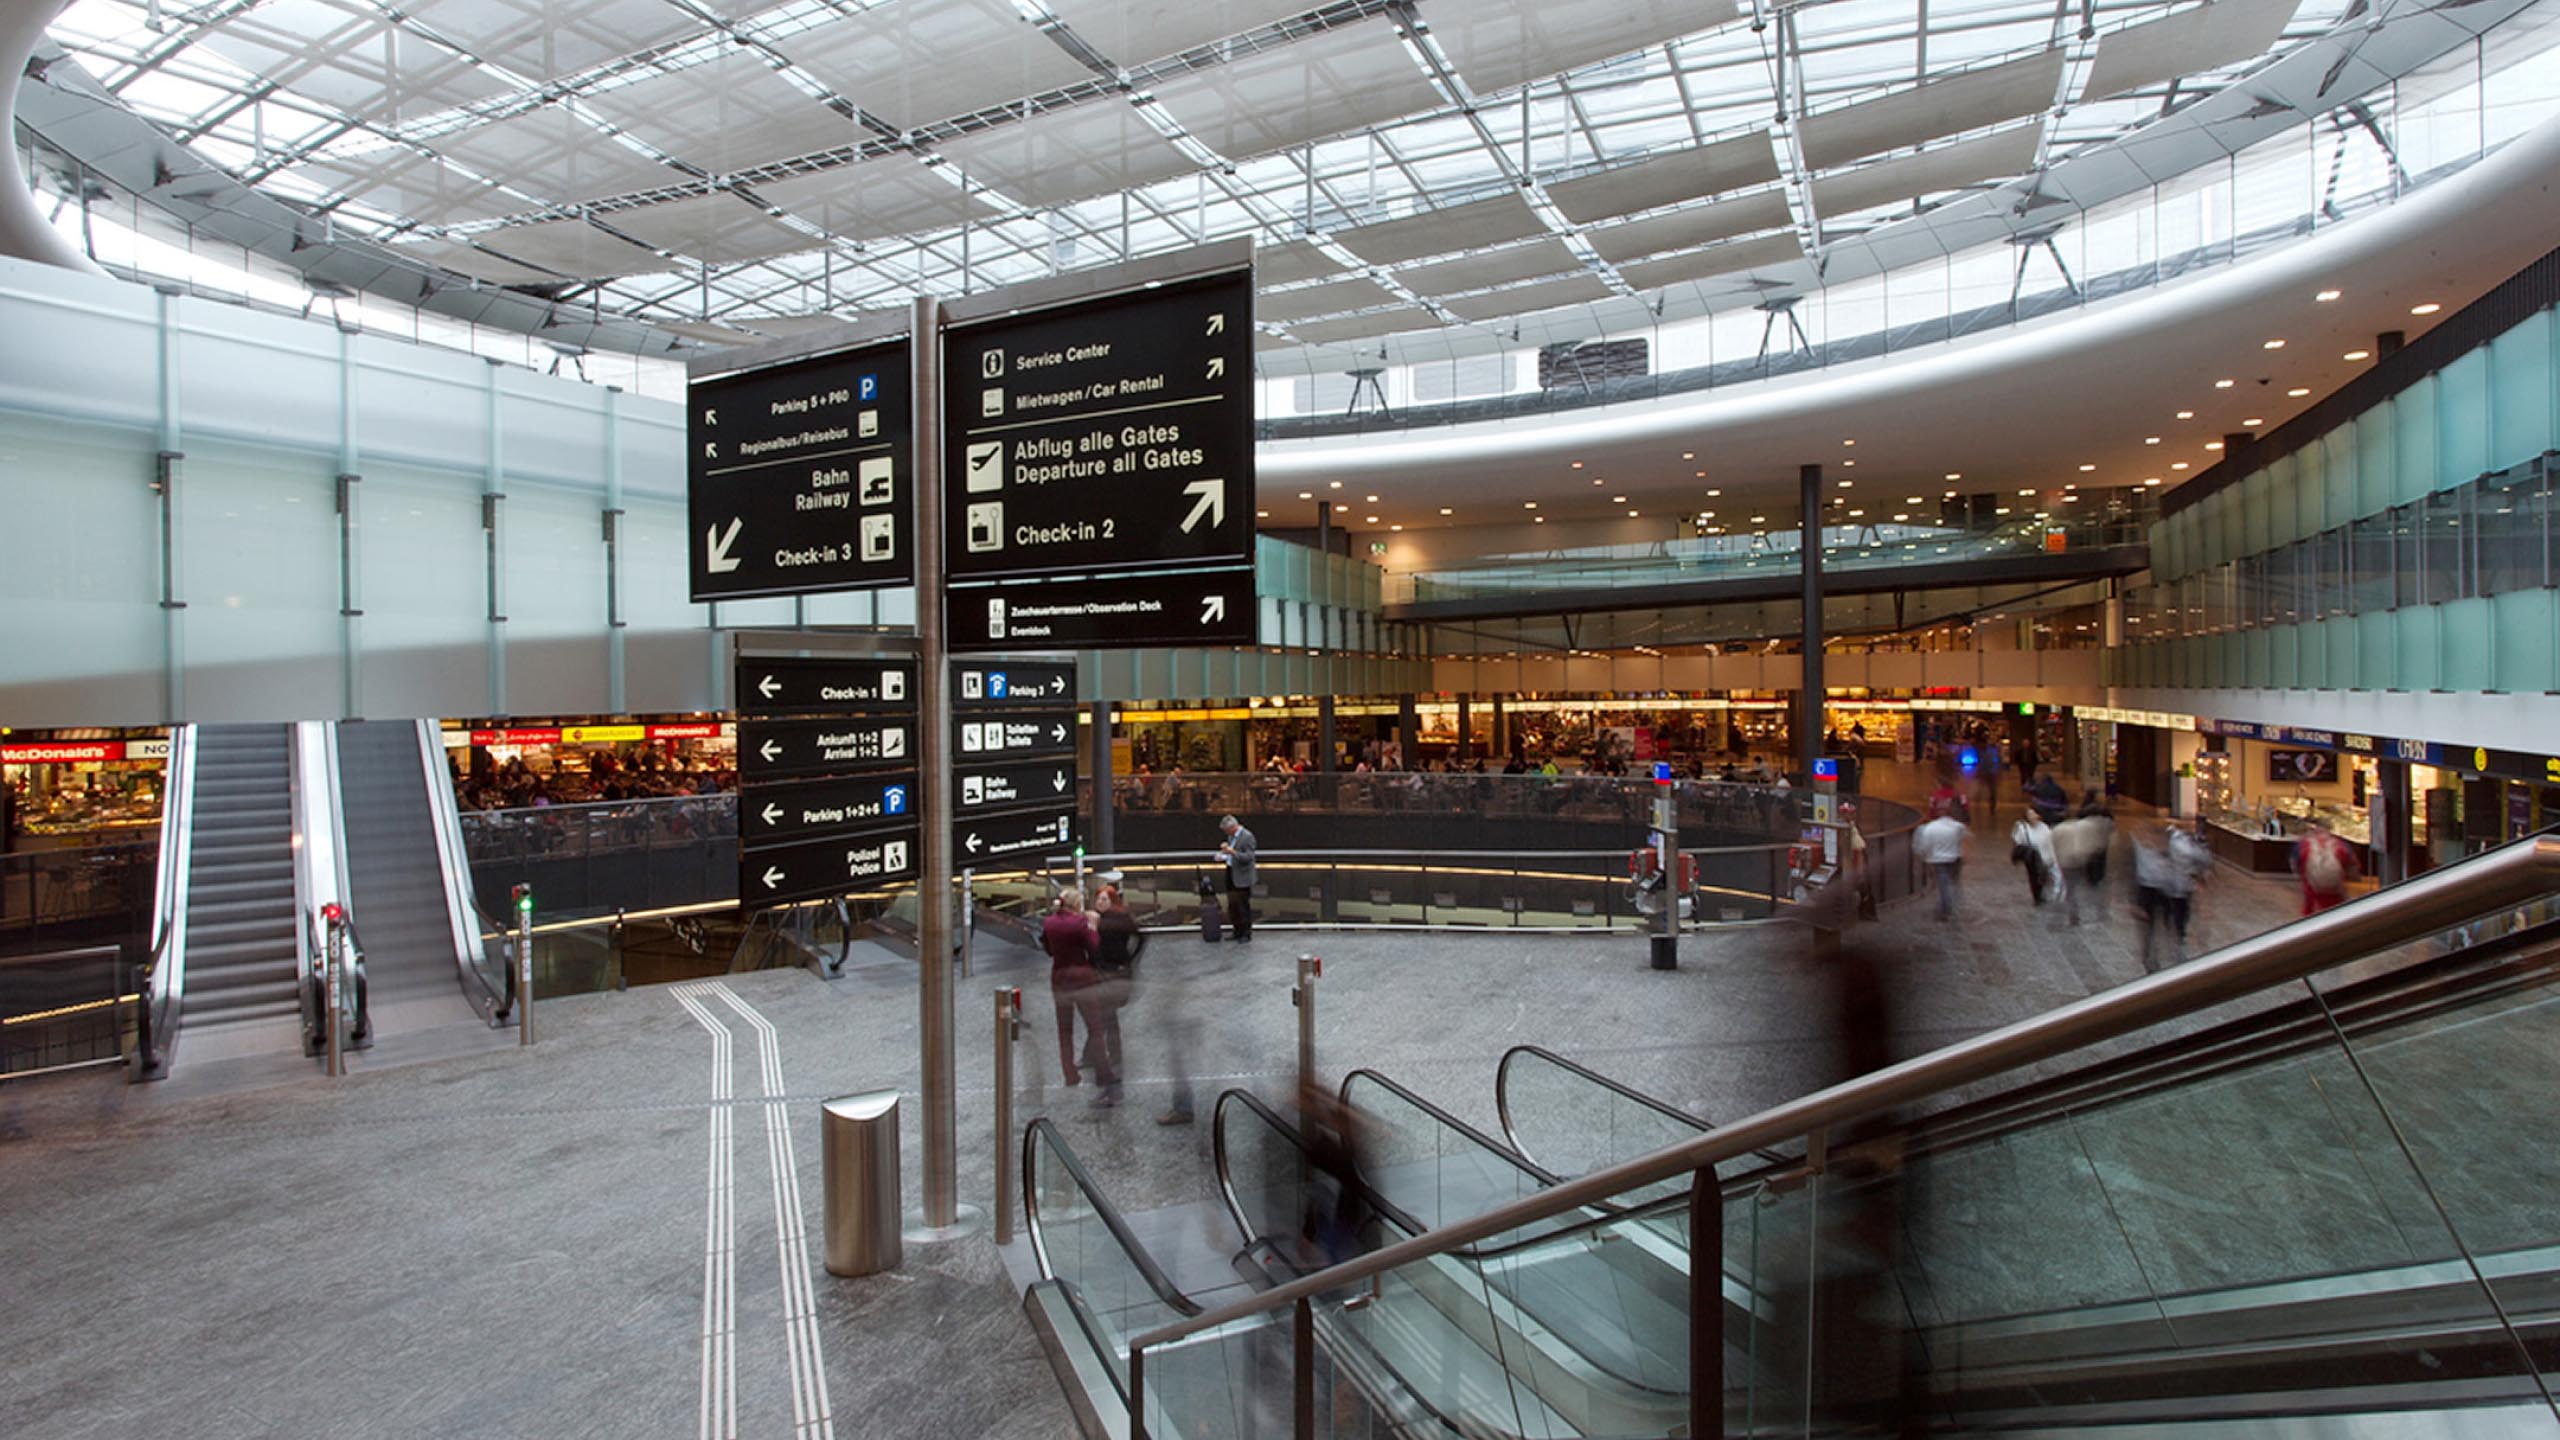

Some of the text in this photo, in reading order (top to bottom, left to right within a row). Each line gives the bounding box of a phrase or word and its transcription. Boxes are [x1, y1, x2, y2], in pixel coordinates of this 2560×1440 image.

[1017, 344, 1110, 370] Service Center
[1120, 374, 1163, 393] Rental
[772, 400, 808, 414] Parking
[811, 395, 818, 408] 5
[1015, 425, 1179, 460] Abflug alle Gates
[1015, 448, 1203, 484] Departure all Gates
[813, 469, 849, 487] Bahn
[796, 492, 850, 510] Railway
[1016, 519, 1114, 545] Check-in 2
[775, 543, 851, 566] Check-in 3
[1139, 600, 1162, 611] Deck
[821, 687, 877, 700] Check-in 1
[1009, 685, 1038, 698] Parking
[817, 731, 878, 748] Ankunft 1+2
[1, 745, 105, 760] McDonald's
[824, 745, 878, 760] Arrival 1+2
[985, 777, 1007, 789] Bahn
[986, 787, 1017, 800] Railway
[803, 809, 843, 823] Parking
[847, 847, 880, 865] Polizei
[849, 861, 880, 876] Police
